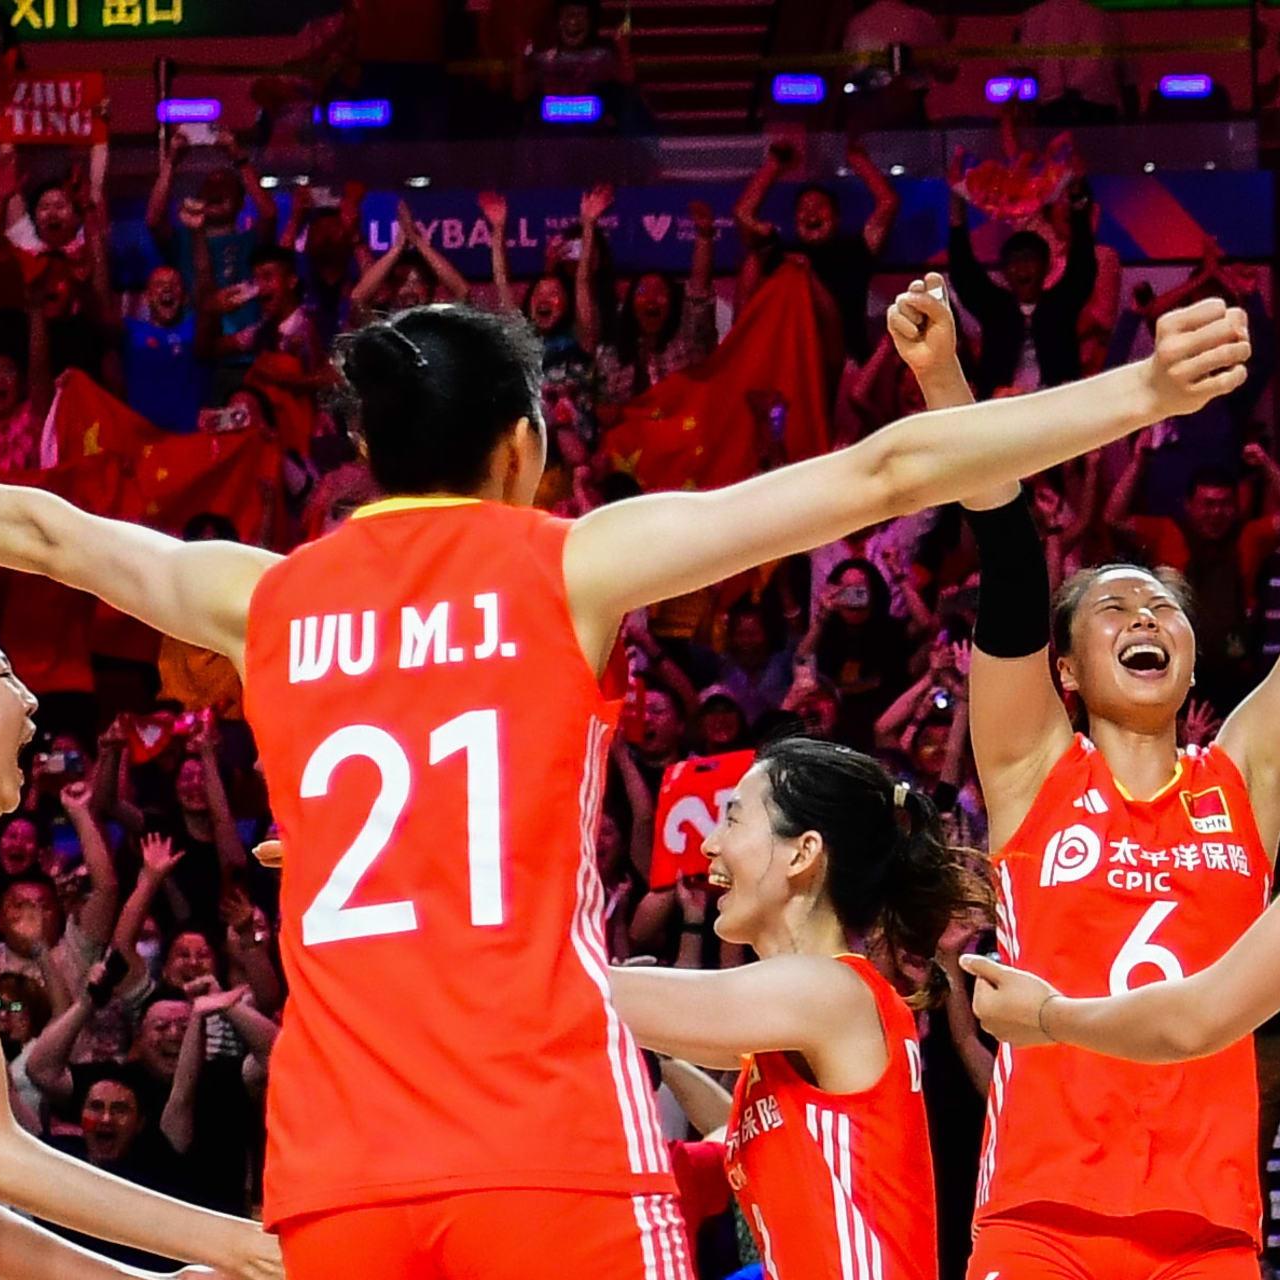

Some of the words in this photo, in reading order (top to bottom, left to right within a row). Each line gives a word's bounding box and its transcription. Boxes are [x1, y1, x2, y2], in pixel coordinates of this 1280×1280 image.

[288, 610, 376, 685] WU
[398, 592, 518, 670] M.J.
[299, 708, 504, 947] 21
[1108, 836, 1252, 878] 太平洋保险
[1194, 818, 1227, 830] CHN
[1106, 869, 1172, 893] CPIC
[1108, 900, 1185, 998] 6
